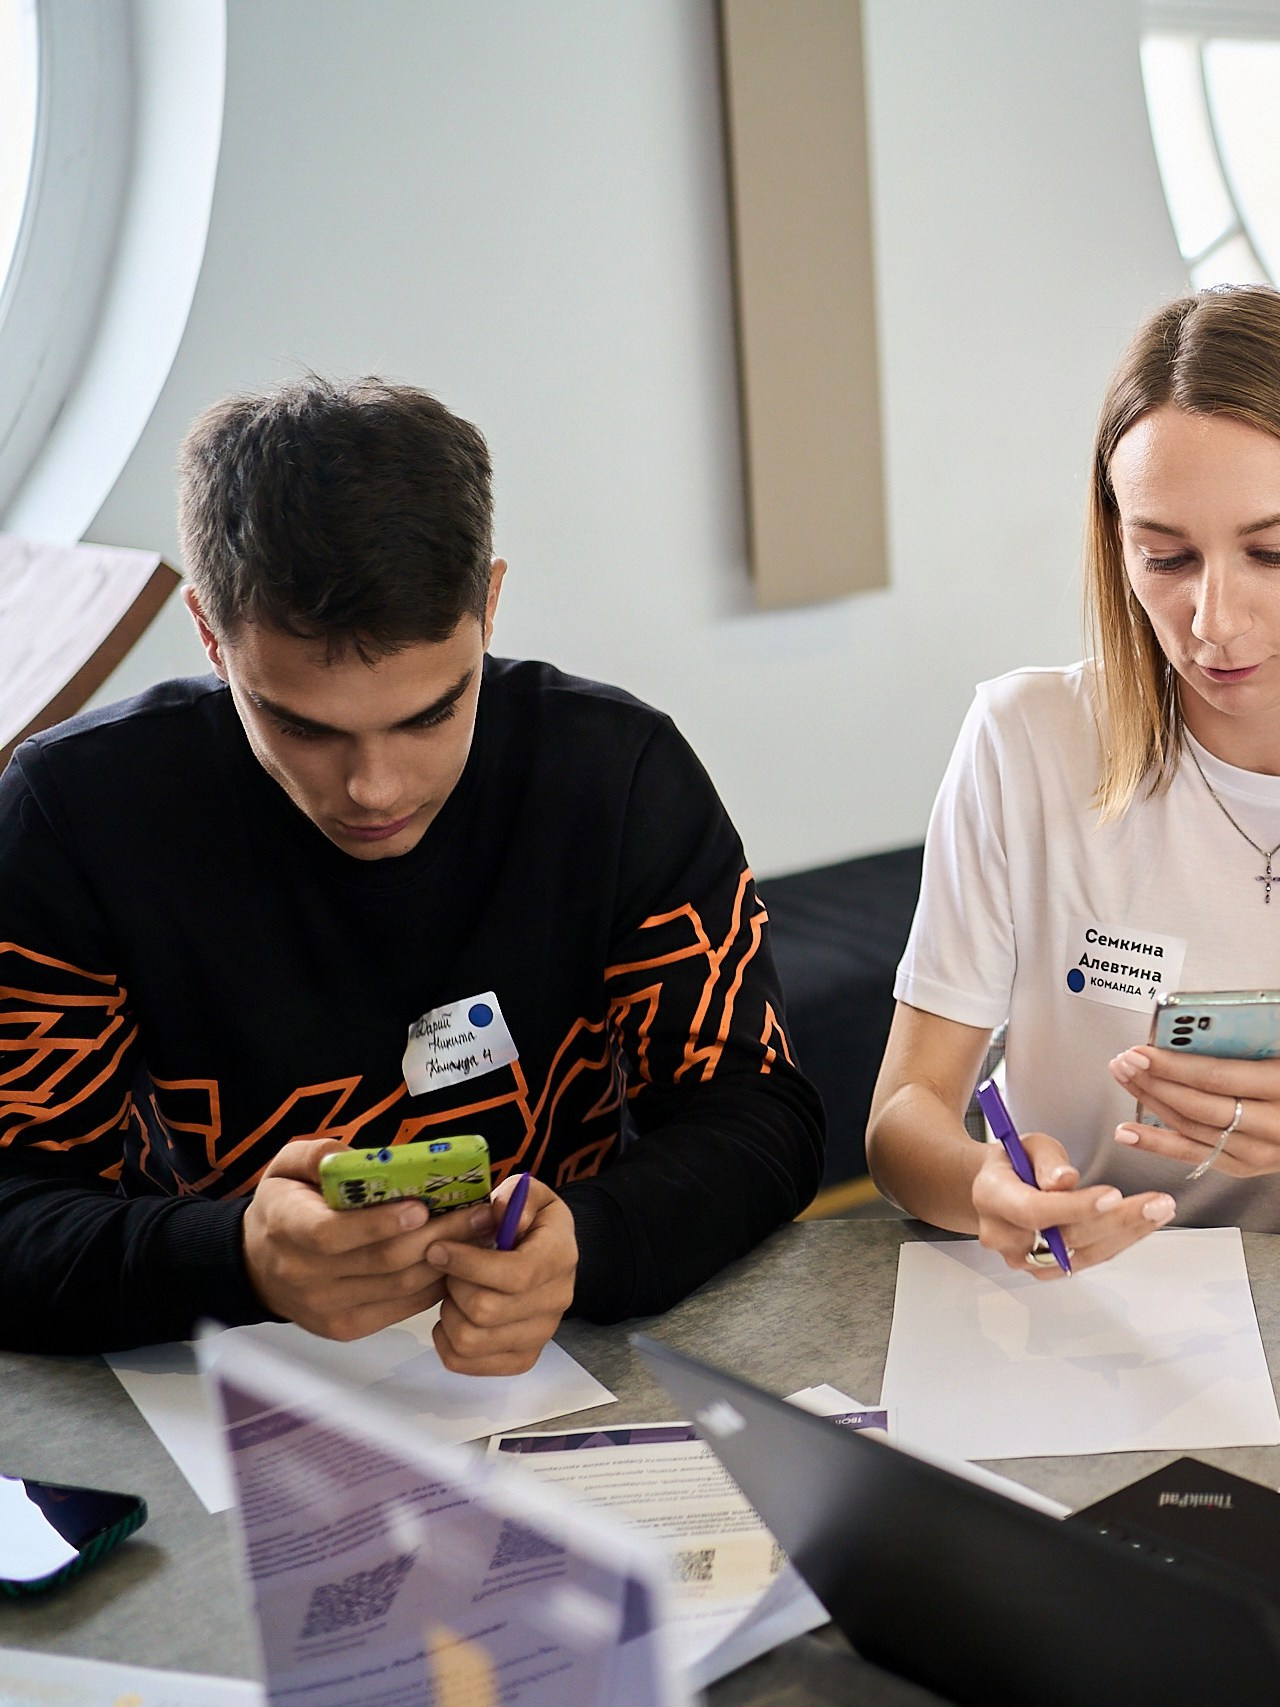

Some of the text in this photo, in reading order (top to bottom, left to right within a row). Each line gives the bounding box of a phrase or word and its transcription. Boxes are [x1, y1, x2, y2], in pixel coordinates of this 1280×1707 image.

[1085, 928, 1164, 958] Семкина
[1079, 952, 1162, 983] Алевтина
[1090, 976, 1157, 1000] КОМАНДА 4
[428, 1031, 476, 1054] Никита
[426, 1048, 494, 1078] Команда 4
[1159, 1492, 1233, 1509] ThinkPad
